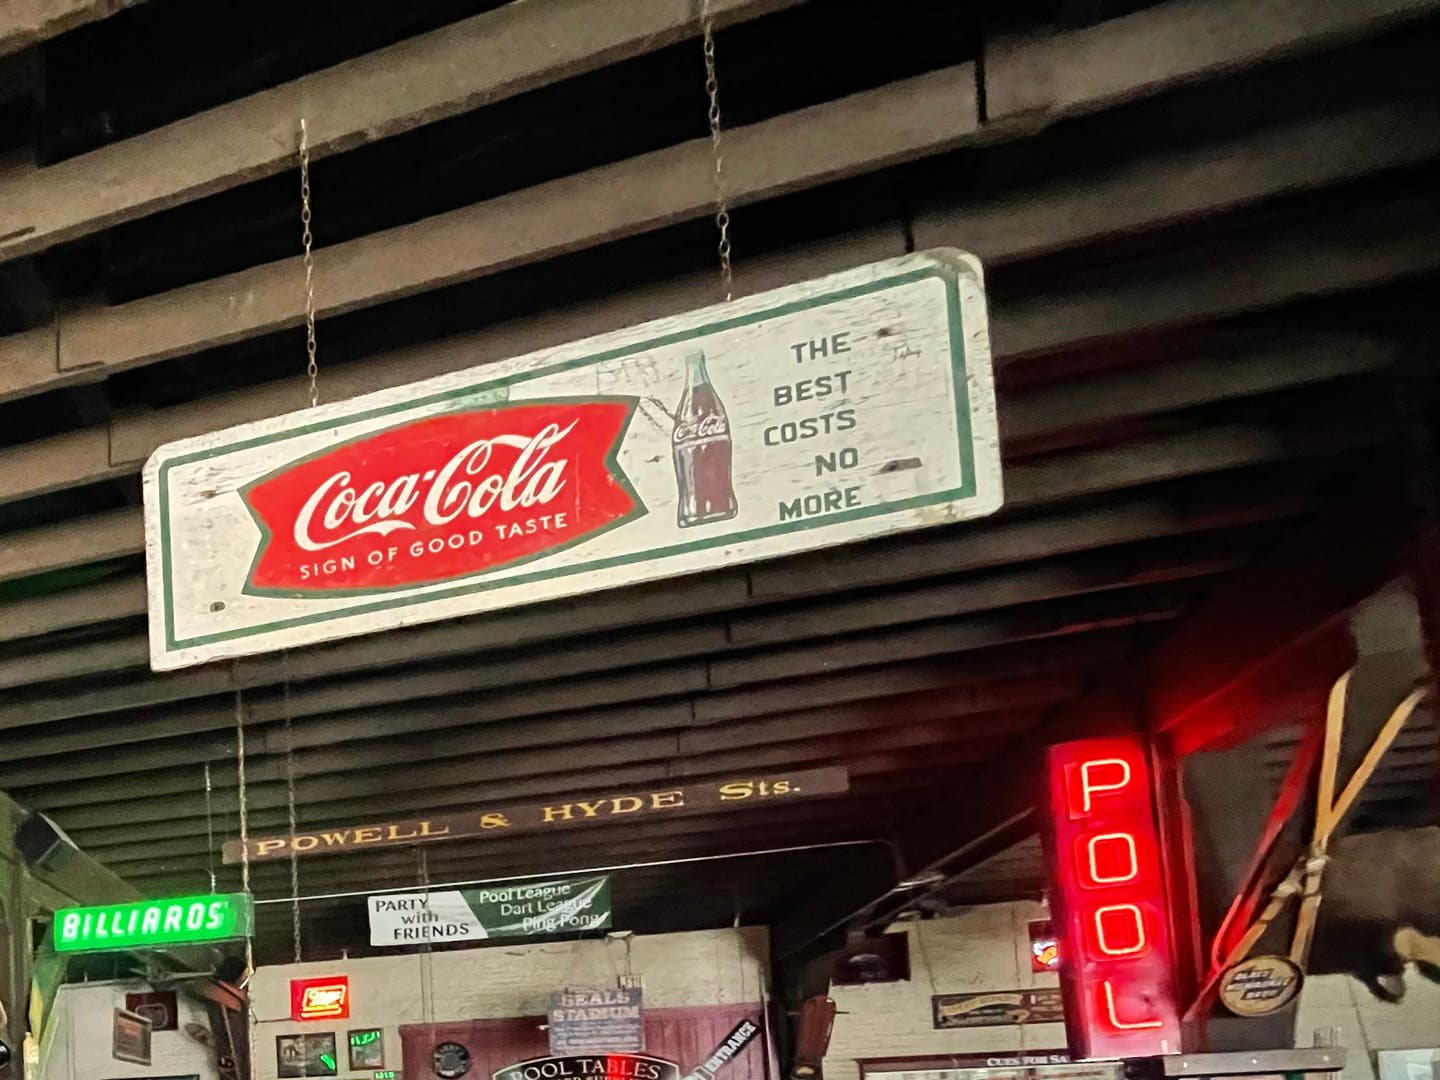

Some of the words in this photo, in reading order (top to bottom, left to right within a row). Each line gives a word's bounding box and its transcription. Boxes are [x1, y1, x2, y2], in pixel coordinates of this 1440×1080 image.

[790, 331, 852, 364] THE
[773, 370, 853, 407] BEST
[763, 409, 857, 447] COSTS
[815, 447, 859, 477] NO
[293, 416, 580, 552] Coca-Cola
[778, 486, 863, 522] MORE
[299, 555, 356, 580] SIGN
[367, 546, 399, 566] OF
[409, 529, 483, 558] GOOD
[495, 512, 568, 541] TASTE
[255, 820, 450, 856] POWELL
[480, 812, 511, 829] &
[542, 791, 685, 823] HYDE
[718, 777, 802, 802] Sts.
[375, 898, 429, 913] PARTY
[479, 887, 514, 904] Pool
[516, 883, 571, 902] League
[500, 901, 534, 917] Dart
[1081, 758, 1163, 1029] POOL
[61, 901, 229, 943] BILLIARDS
[393, 922, 470, 941] FRIENDS
[400, 909, 439, 925] with
[560, 990, 631, 1007] SEALS
[703, 1020, 757, 1073] ENTRANCE
[576, 1056, 661, 1080] TABLES
